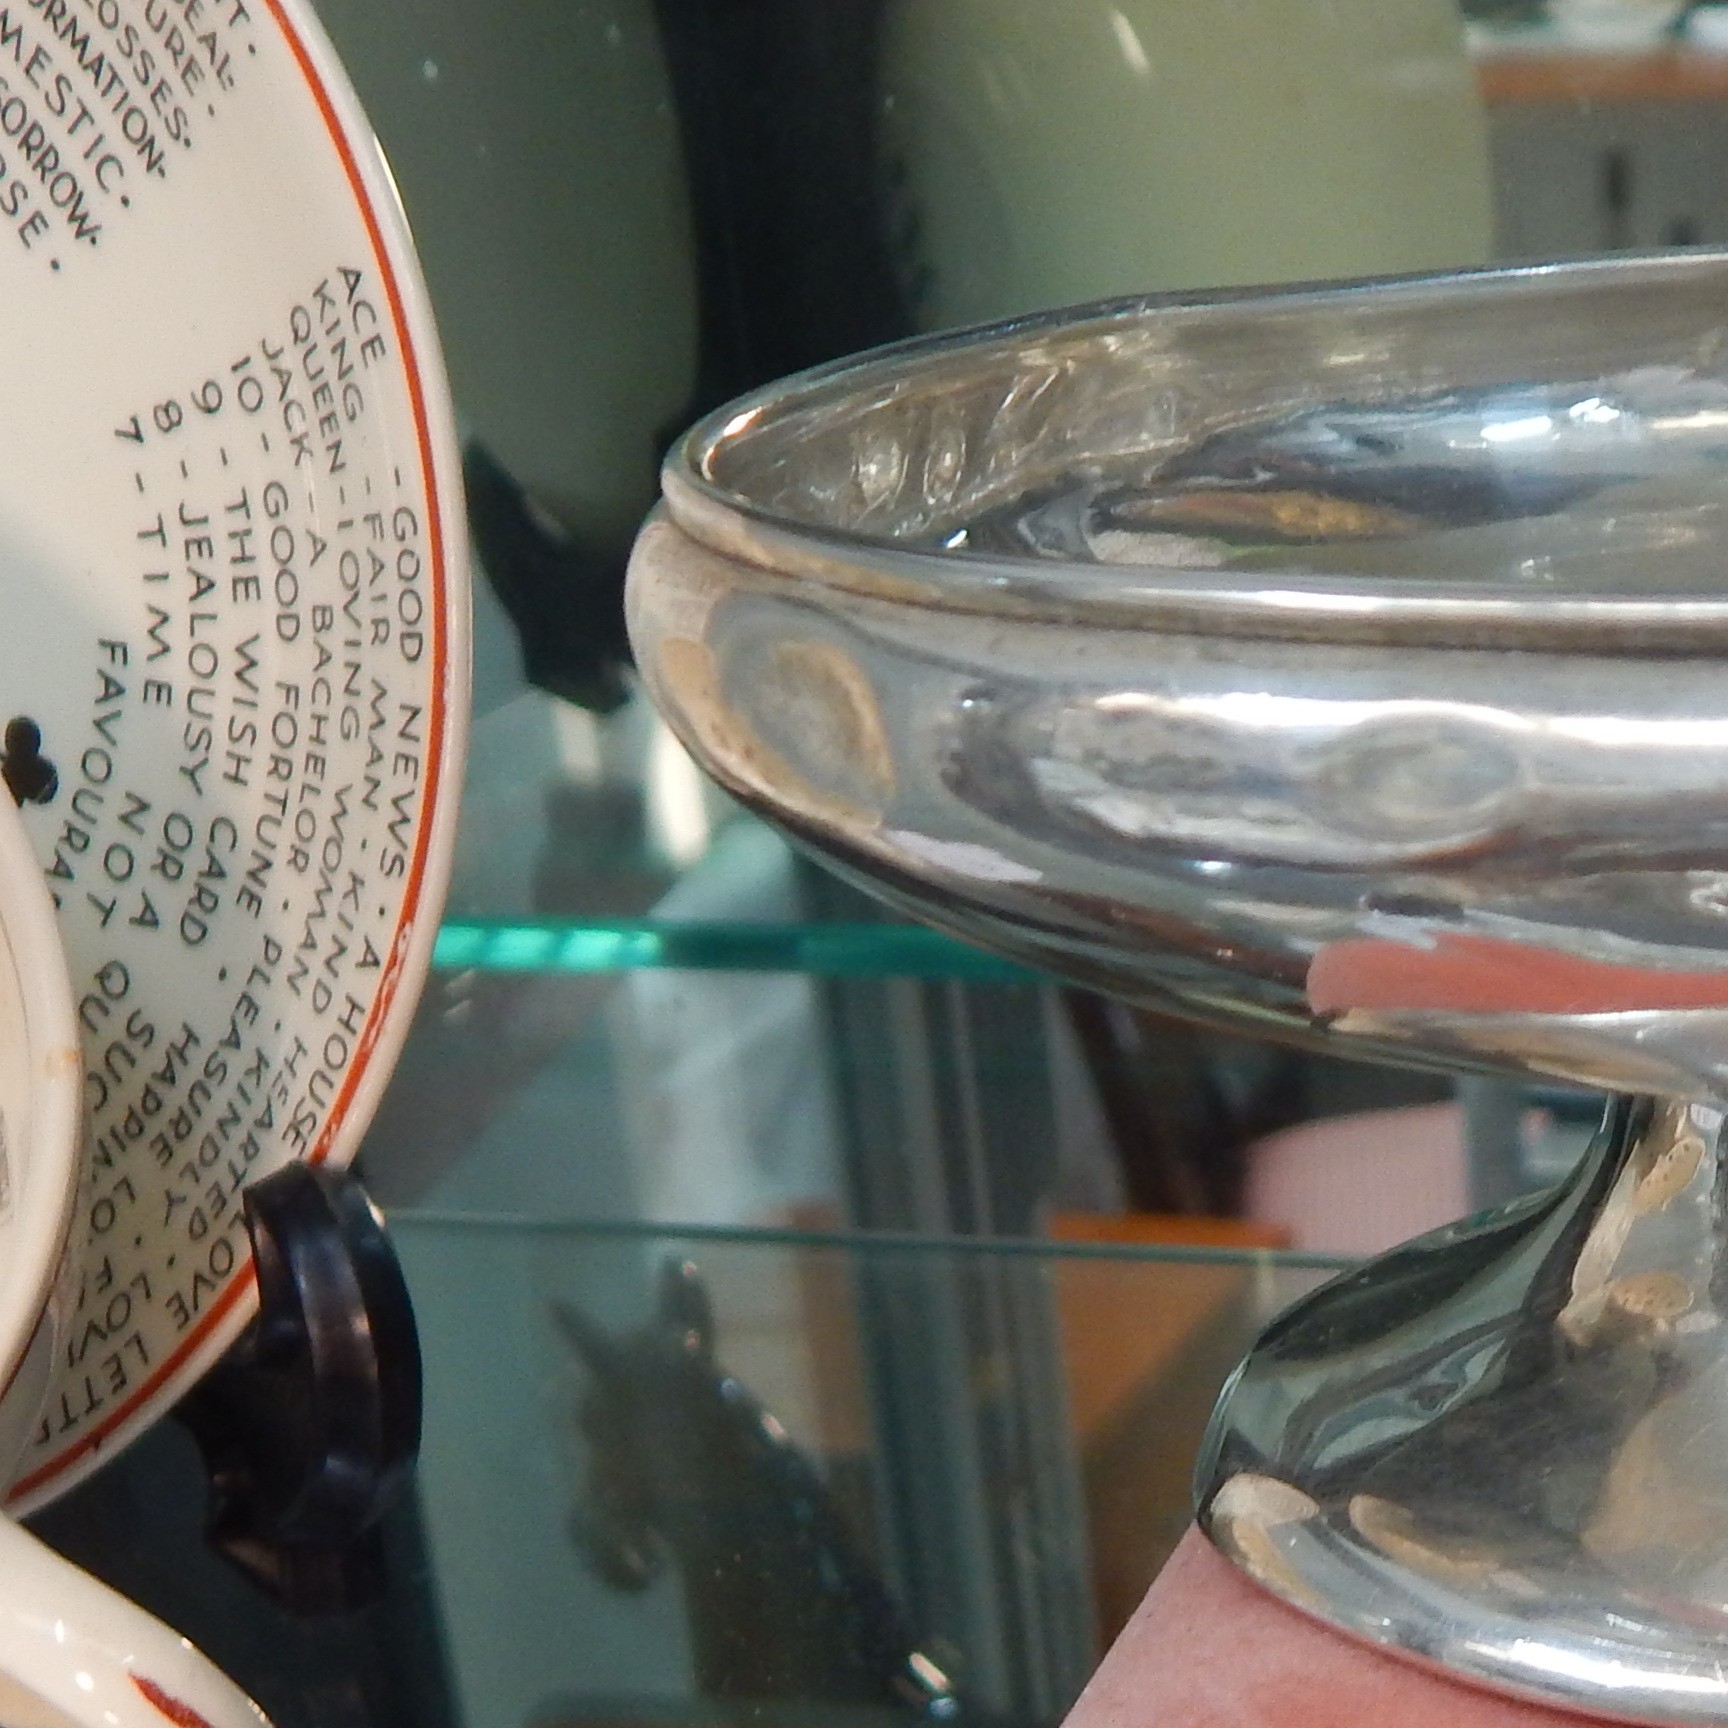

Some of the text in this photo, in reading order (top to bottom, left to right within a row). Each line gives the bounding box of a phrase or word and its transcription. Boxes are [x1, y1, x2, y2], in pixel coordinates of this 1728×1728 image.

[27, 0, 166, 178] RMATION.
[82, 0, 191, 149] OSSES.
[0, 76, 102, 246] ORROW.
[290, 305, 346, 474] QUEEN
[313, 278, 365, 422] KING
[336, 266, 387, 369] ACE
[114, 414, 144, 443] 7
[153, 400, 183, 434] 8
[190, 379, 223, 414] 9
[261, 338, 314, 466] JACK
[225, 486, 262, 603] THE
[231, 355, 264, 413] 10
[263, 481, 300, 642] GOOD
[305, 528, 327, 567] A
[136, 511, 172, 708] TIME
[178, 498, 219, 797] JEALOUSY
[363, 510, 390, 646] FAIR
[392, 506, 424, 662] GOOD
[44, 637, 128, 911] FAVOURA
[222, 633, 261, 787] WISH
[85, 788, 152, 928] NOT
[128, 885, 160, 931] A
[149, 811, 194, 881] OR
[180, 816, 238, 945] CARD
[313, 870, 365, 1014] KIND
[355, 935, 380, 968] A
[150, 934, 282, 1169] PLEASURE
[281, 992, 366, 1157] HOUSE
